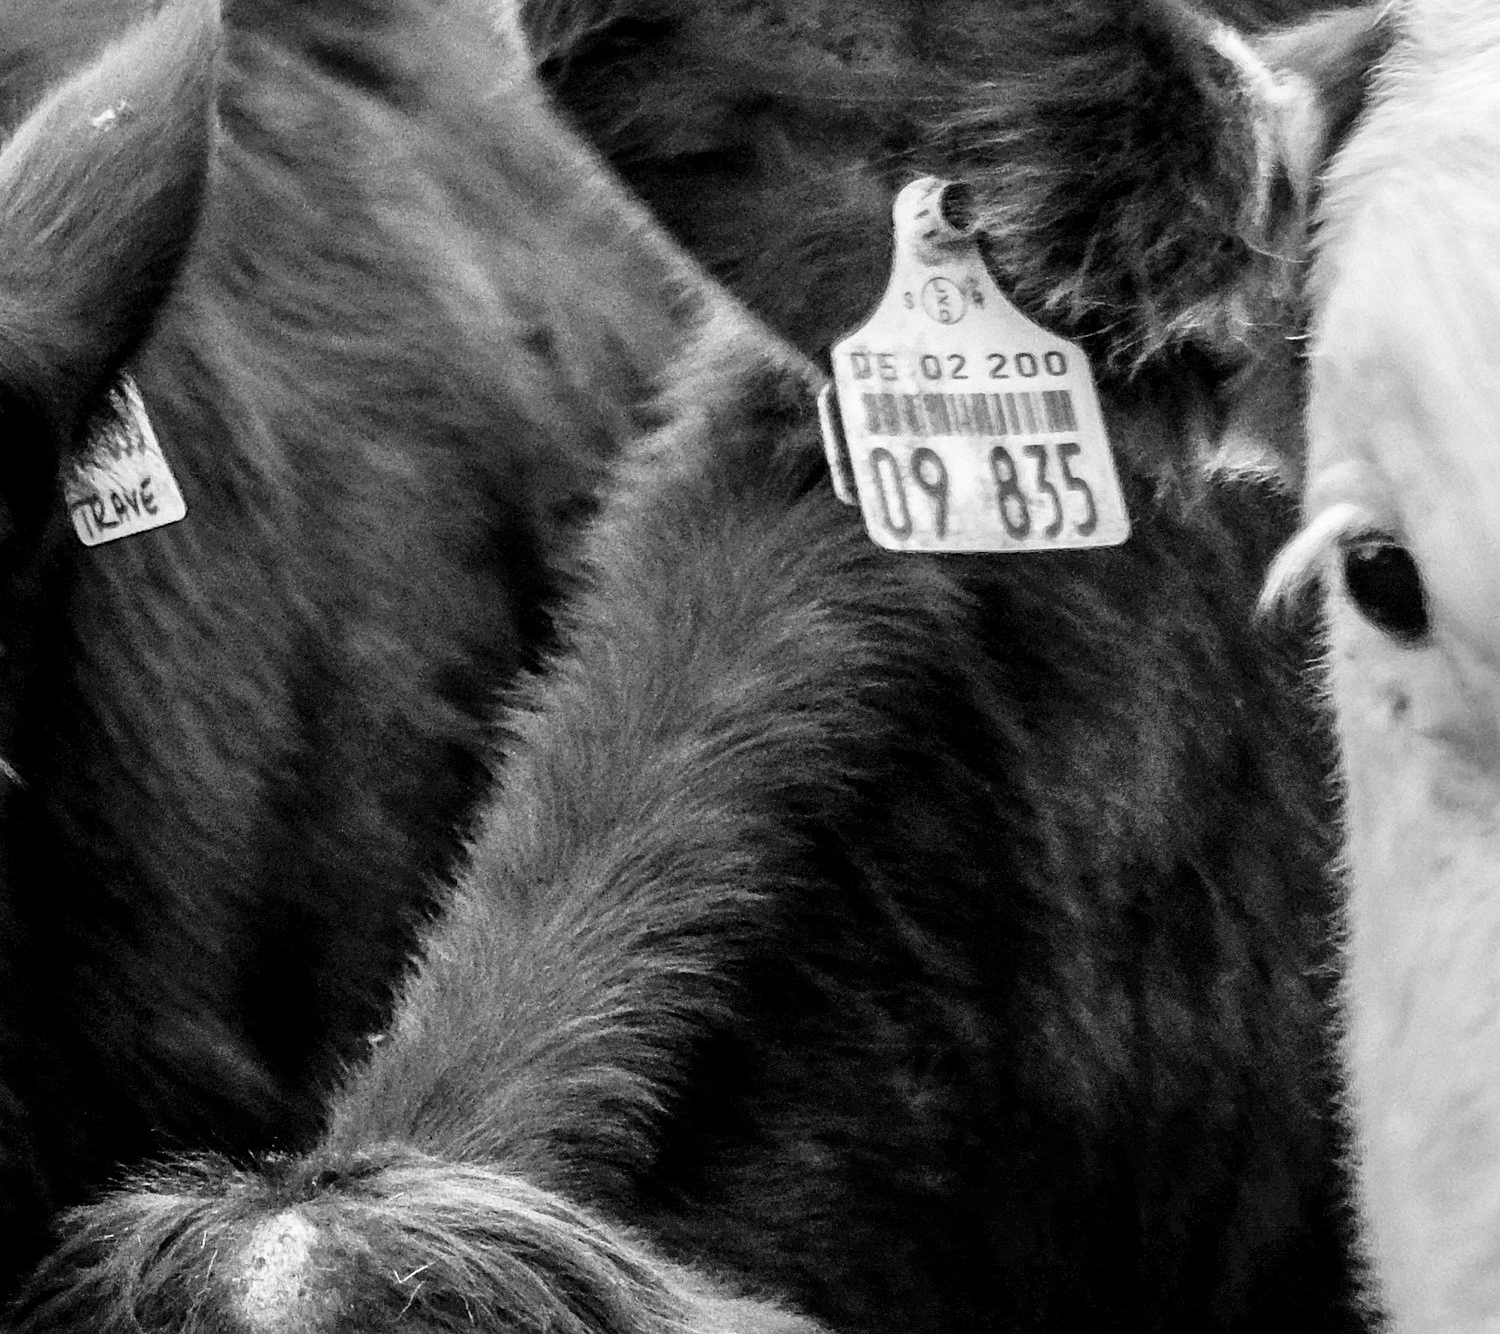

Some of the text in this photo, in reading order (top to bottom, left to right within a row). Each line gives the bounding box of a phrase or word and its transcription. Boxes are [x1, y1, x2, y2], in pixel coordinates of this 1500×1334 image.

[850, 349, 1068, 381] DE 02 200
[869, 442, 1099, 542] 09 835
